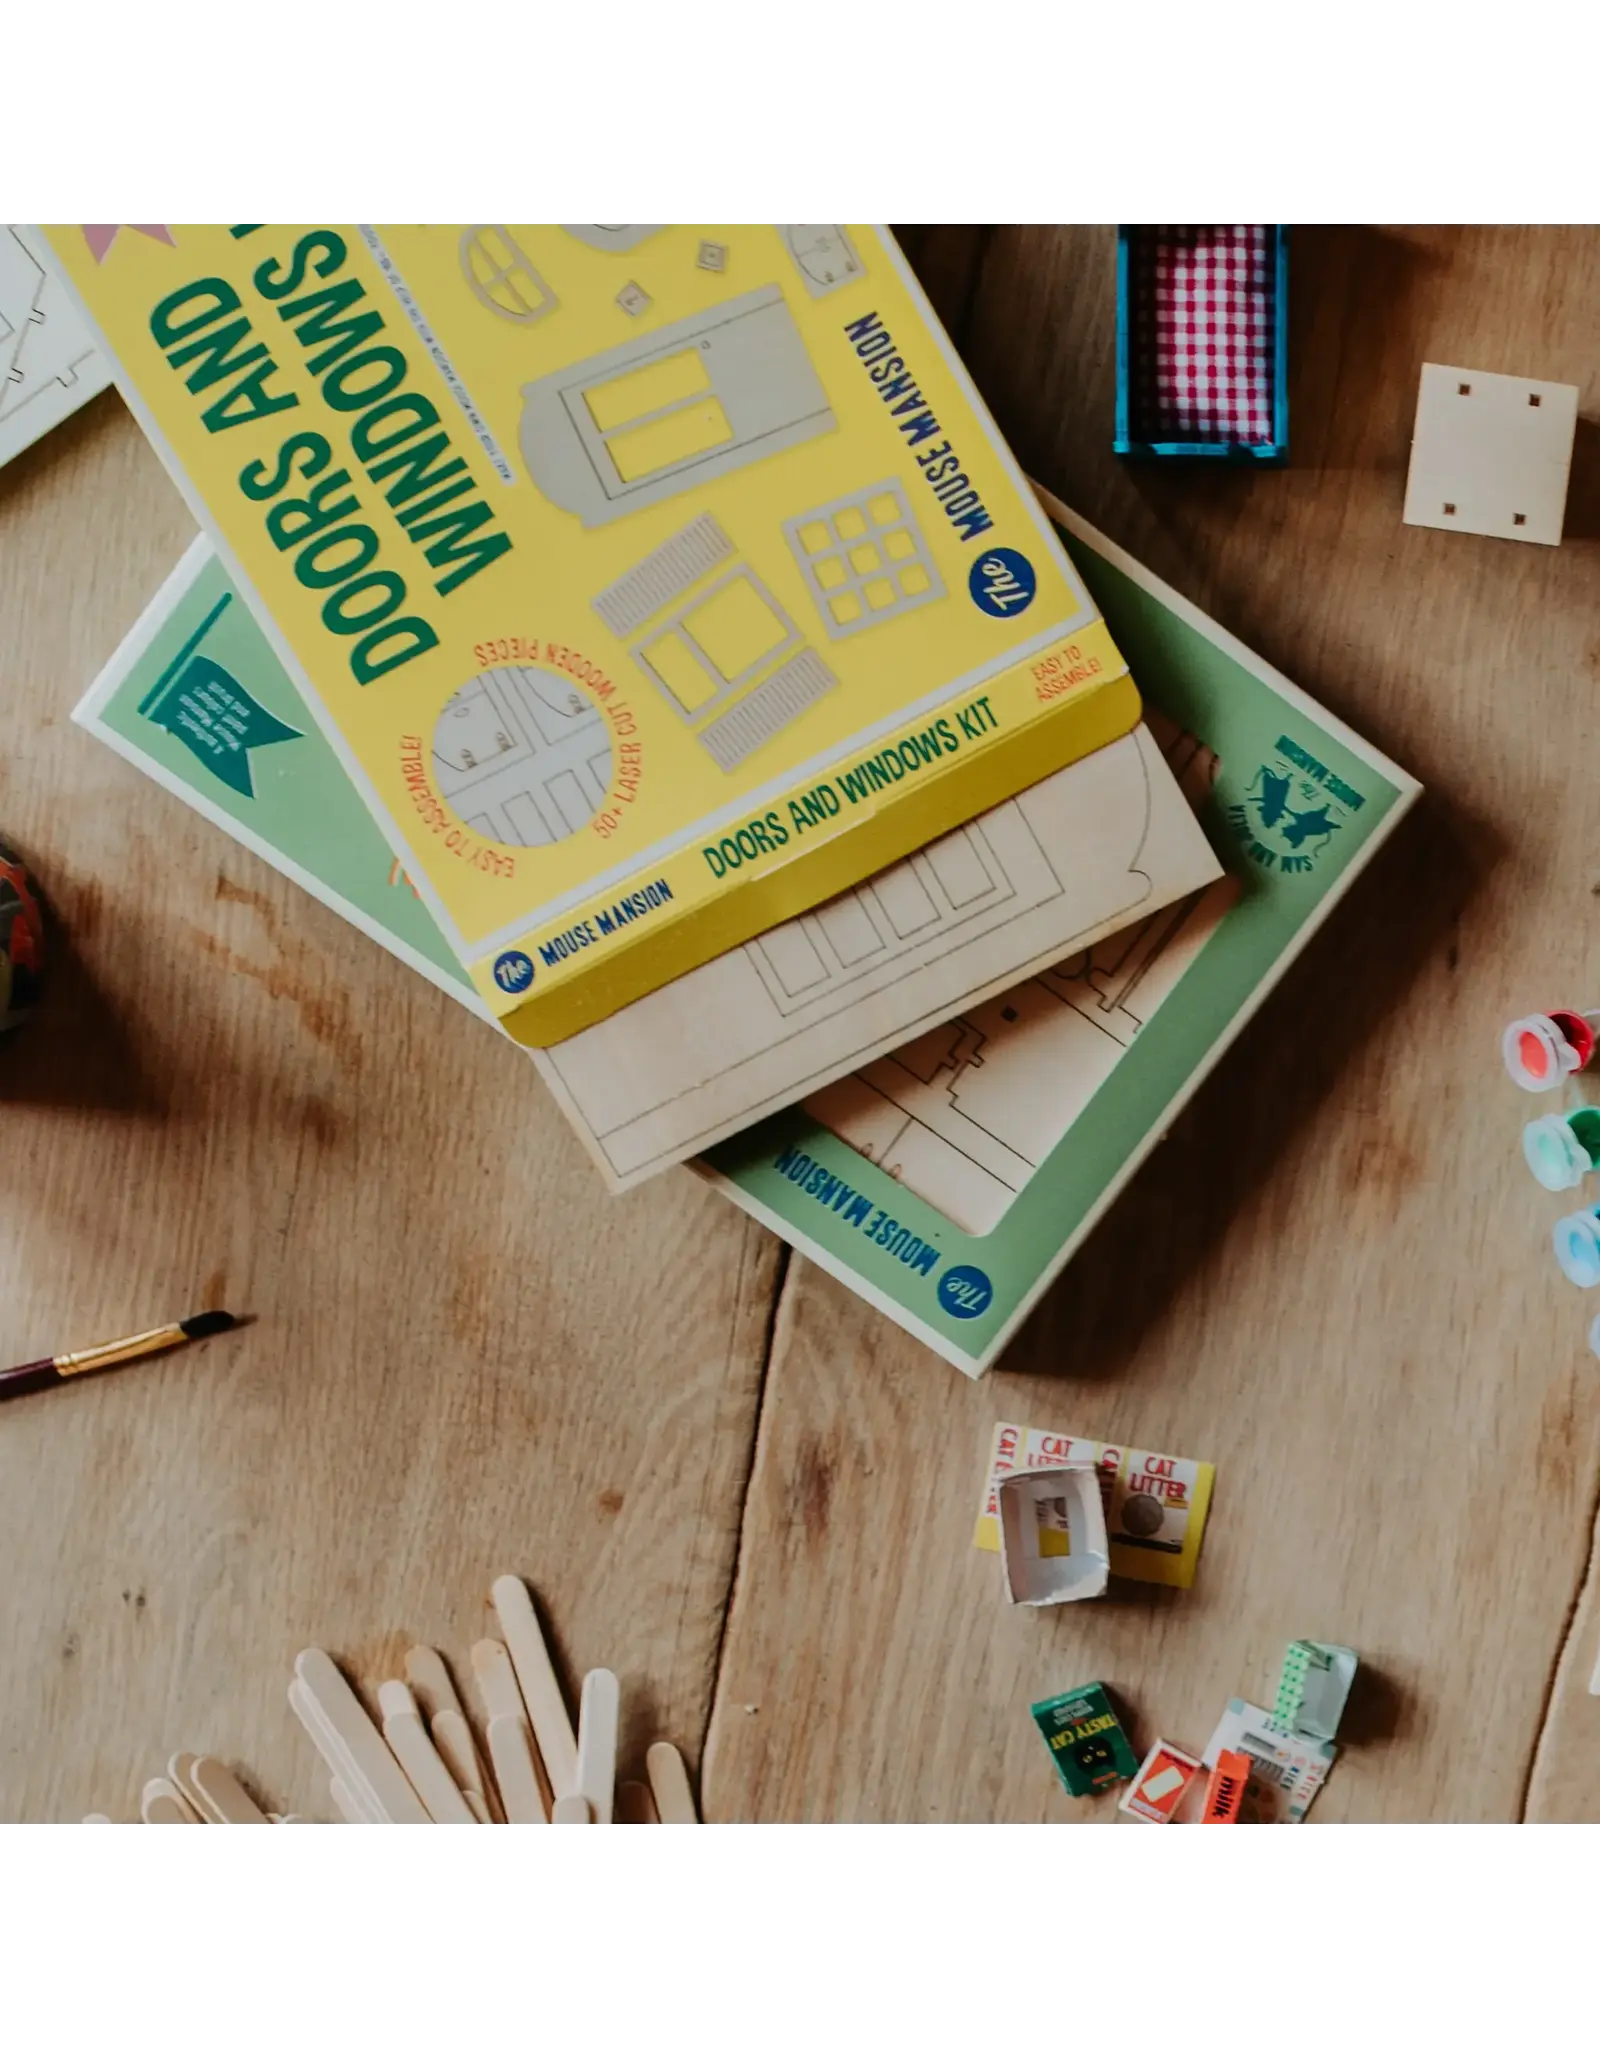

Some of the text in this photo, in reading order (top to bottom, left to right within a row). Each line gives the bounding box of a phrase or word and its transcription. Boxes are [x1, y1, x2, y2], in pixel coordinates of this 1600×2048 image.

[149, 277, 300, 433] AND
[253, 230, 513, 597] WINDOWS
[844, 311, 1029, 610] The MOUSE MANSION
[239, 430, 440, 686] DOORS
[1031, 645, 1081, 681] EASY TO
[474, 638, 641, 840] 50+ LASER CUT WOODEN PIECES
[702, 696, 999, 879] DOORS AND WINDOWS KIT
[444, 829, 470, 856] TO
[468, 846, 515, 878] EASY
[538, 920, 599, 967] MOUSE
[594, 878, 674, 937] MANSION
[773, 1142, 989, 1311] The MOUSE MANSION
[999, 1428, 1018, 1460] CAT
[1041, 1436, 1074, 1457] CAT
[1130, 1479, 1187, 1498] LITTER
[1144, 1456, 1178, 1478] CAT
[1050, 1713, 1119, 1751] TASTY CAT
[1211, 1776, 1234, 1820] milk
